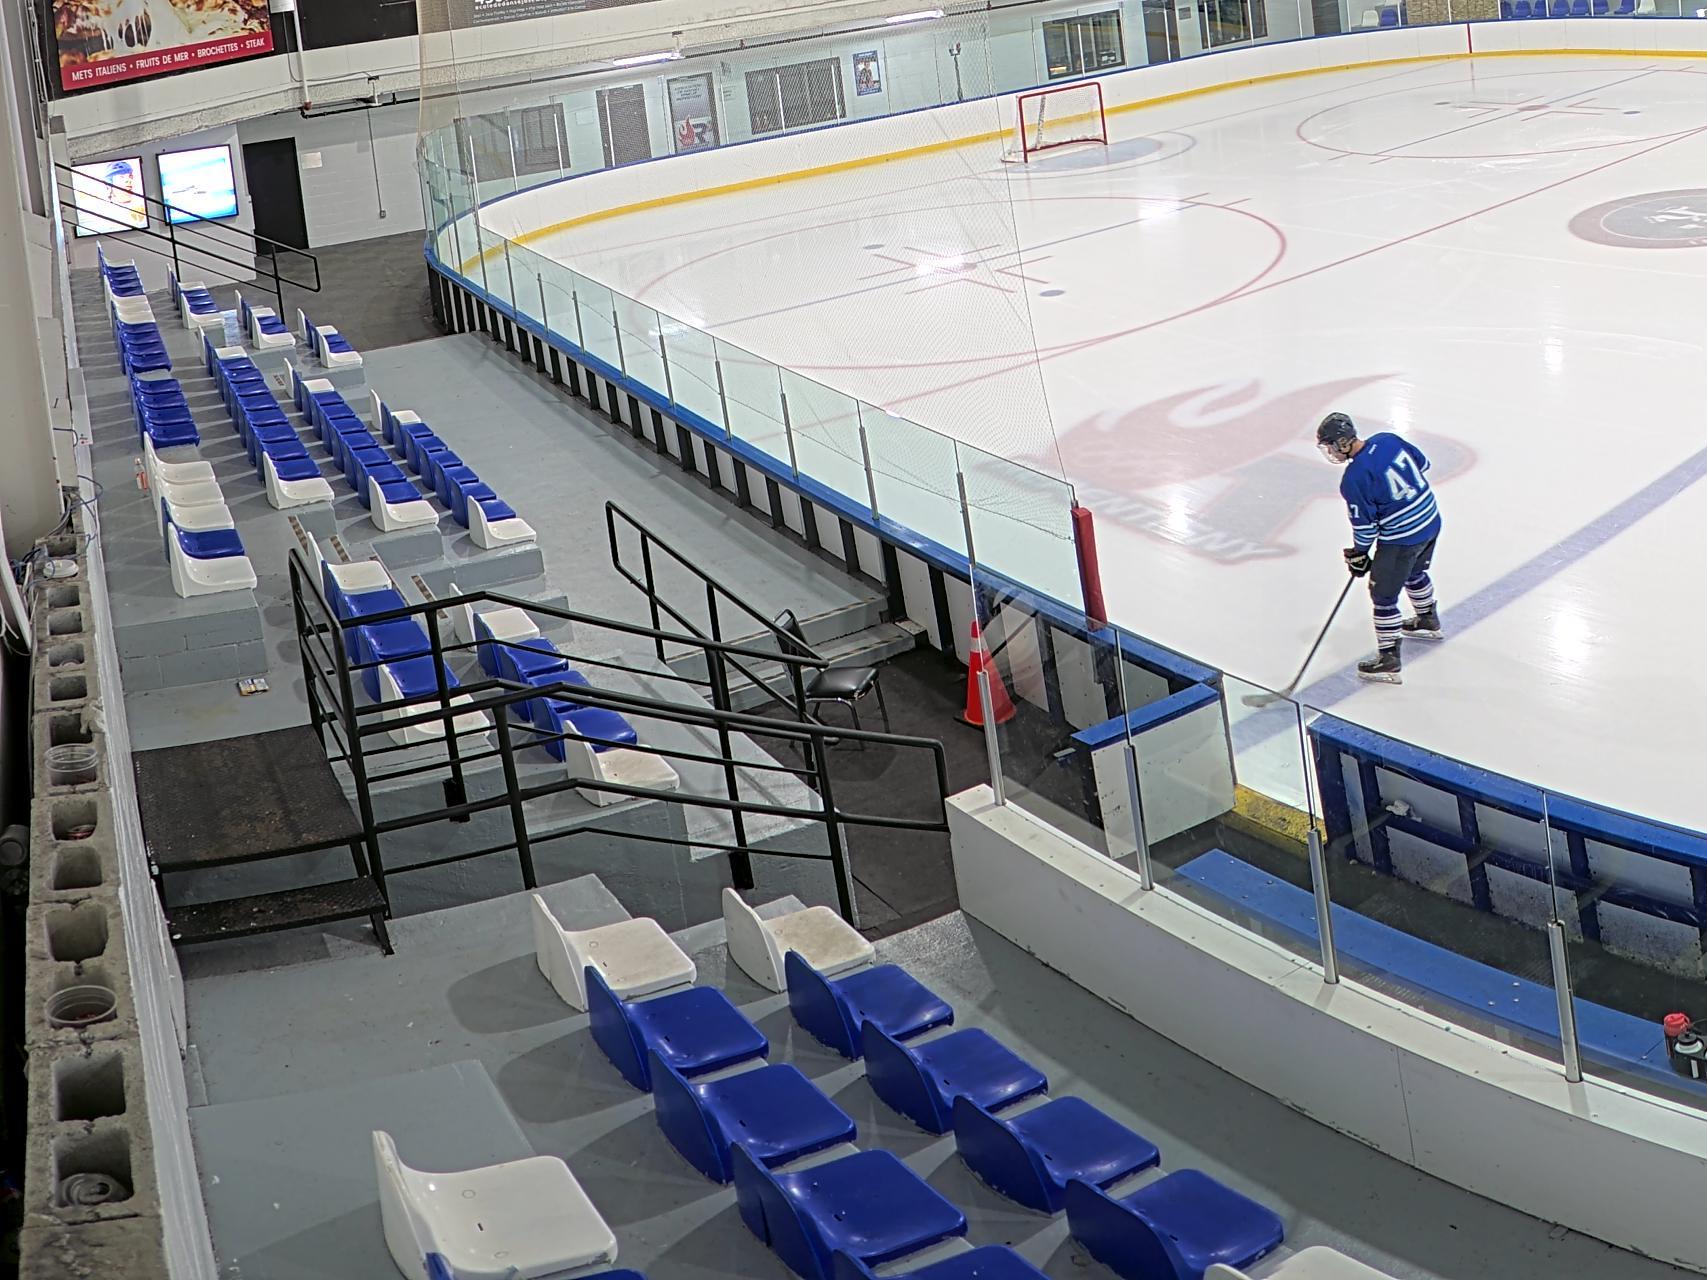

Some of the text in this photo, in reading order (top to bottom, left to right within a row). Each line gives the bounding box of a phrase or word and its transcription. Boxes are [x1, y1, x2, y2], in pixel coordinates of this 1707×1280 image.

[72, 38, 265, 81] METS ITALIENS FRUITS DE MER BROCHETTES STEAK
[1385, 448, 1426, 500] 47
